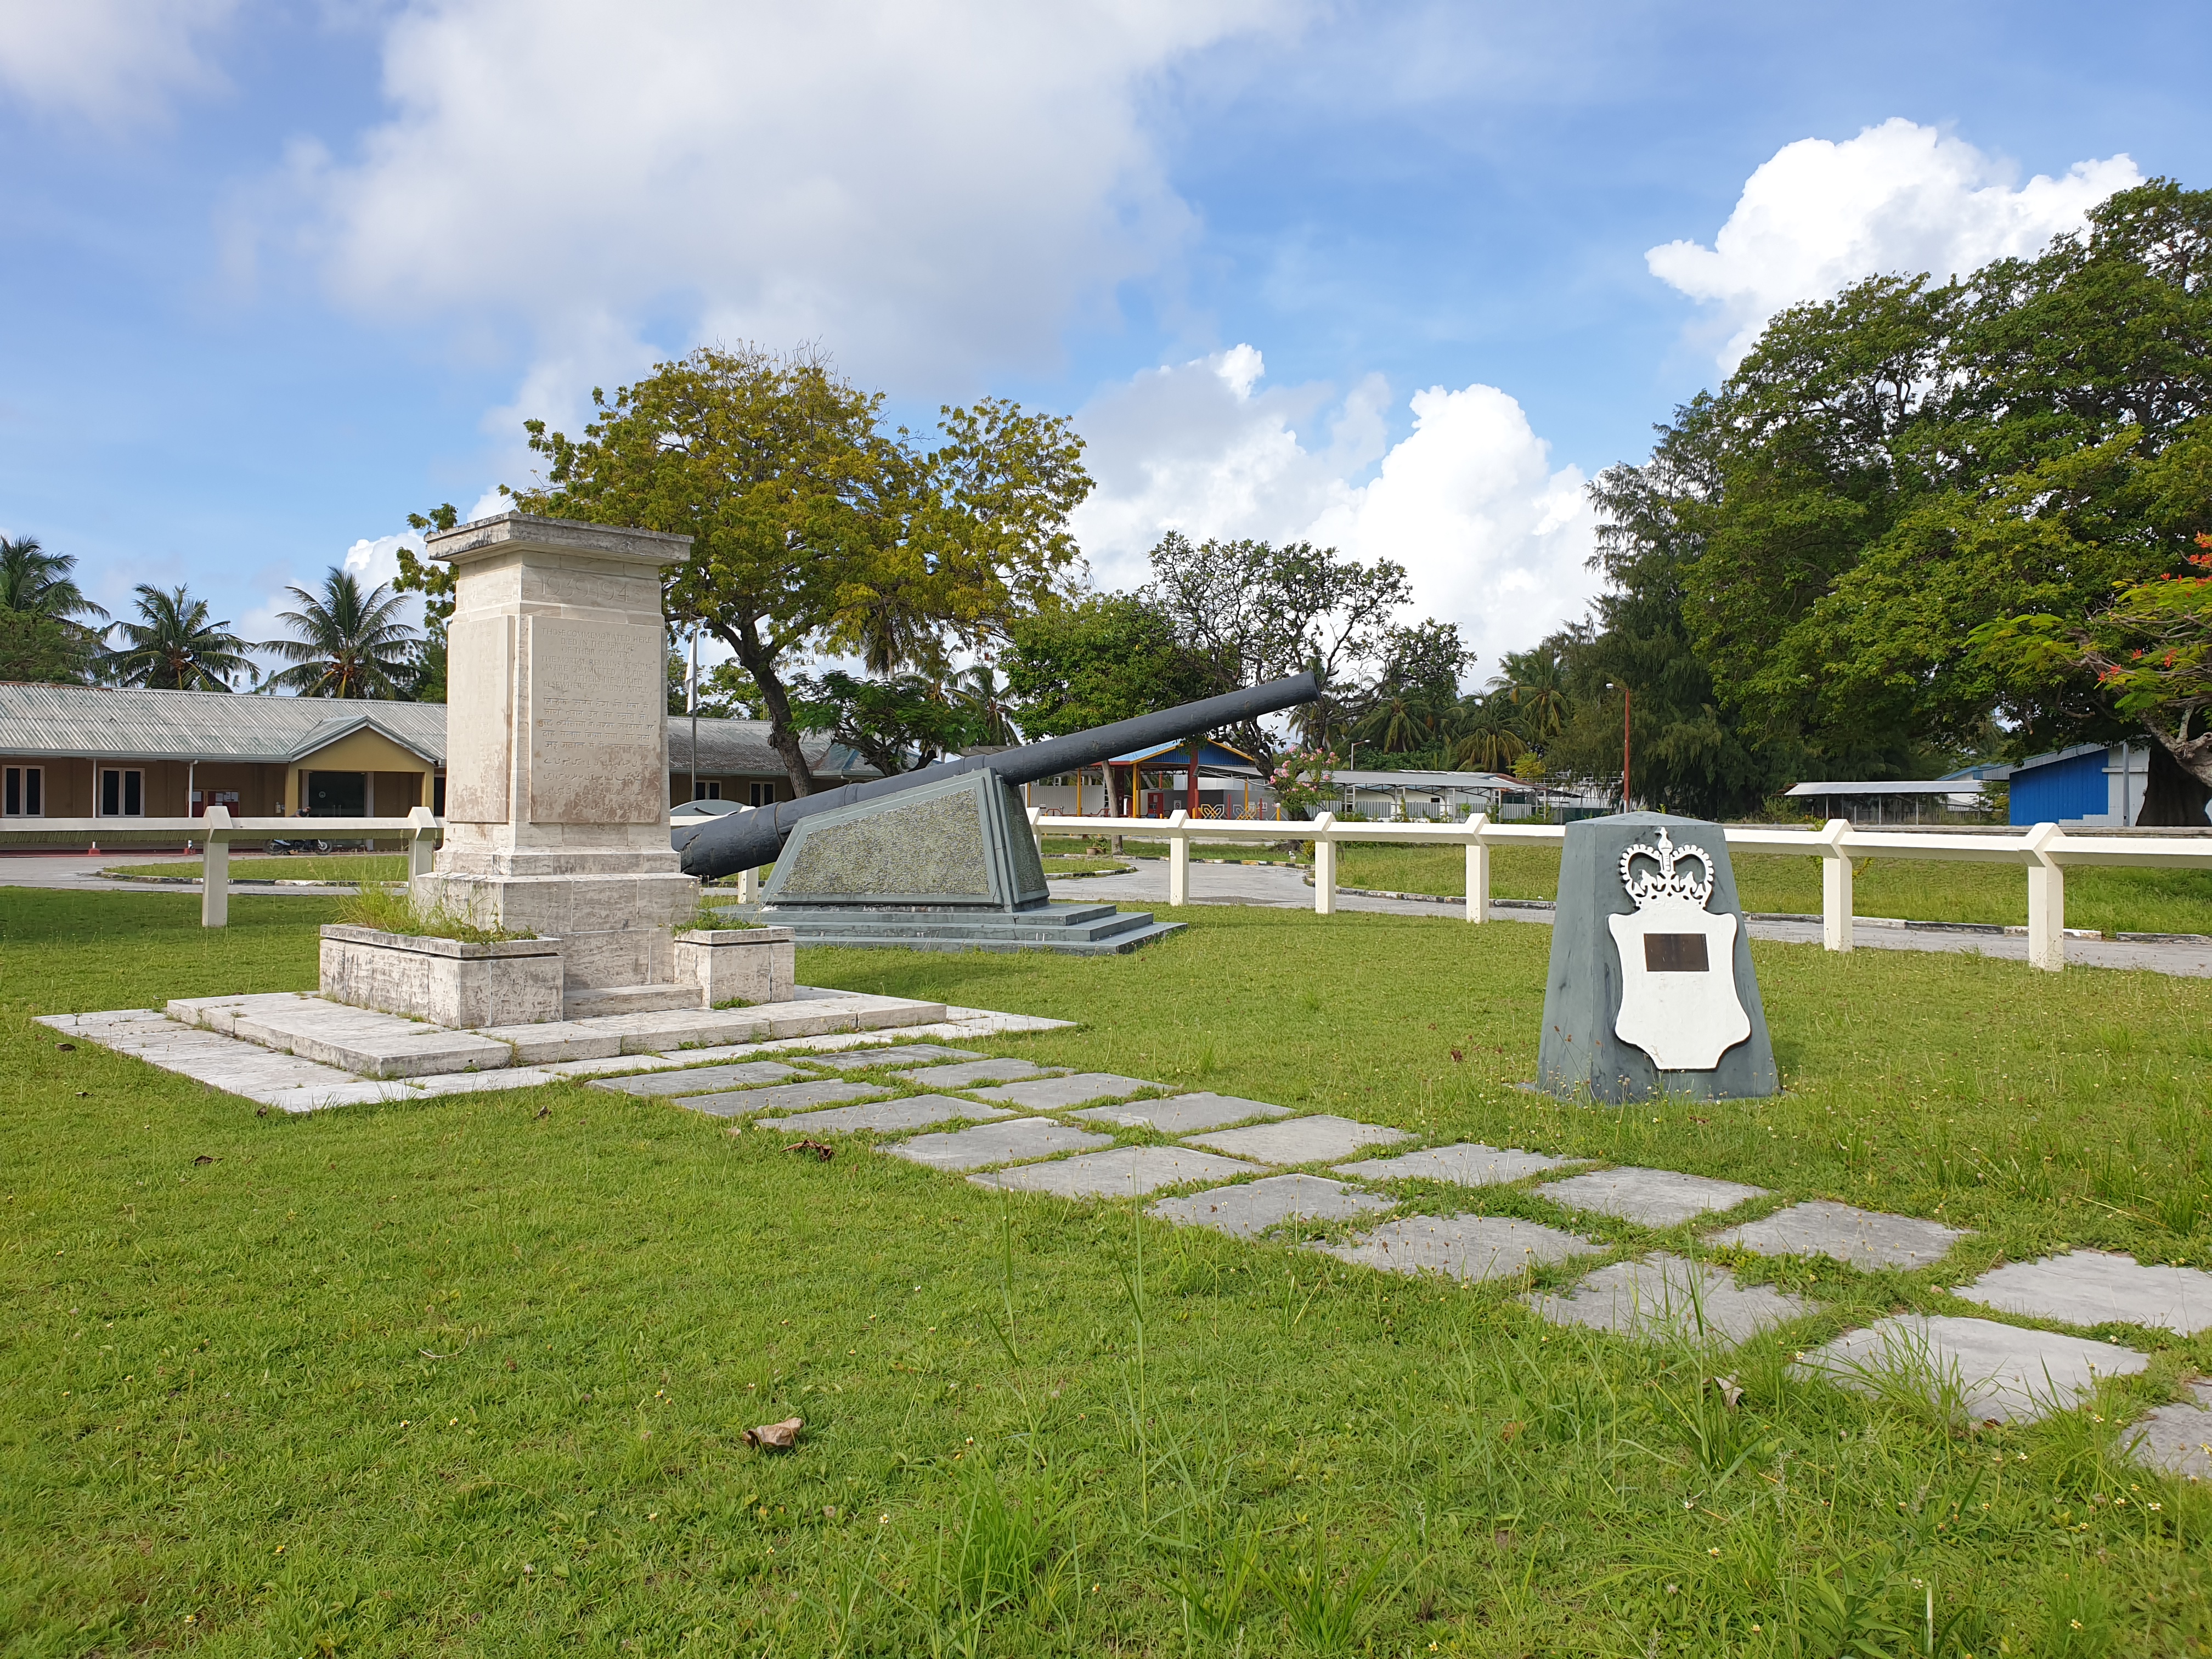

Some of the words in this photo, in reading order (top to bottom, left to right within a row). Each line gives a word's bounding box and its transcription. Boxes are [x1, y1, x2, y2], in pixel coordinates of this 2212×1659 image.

[541, 628, 566, 636] THOSE
[567, 630, 631, 642] COMMEMORATED
[608, 642, 634, 651] SERVICE
[599, 649, 633, 658] COUNTRY
[558, 657, 586, 665] MORTAL
[589, 659, 620, 668] REMAINS
[572, 665, 616, 675] COMMITTED
[573, 674, 601, 682] OTHERS
[544, 681, 586, 690] ELSEWHERE
